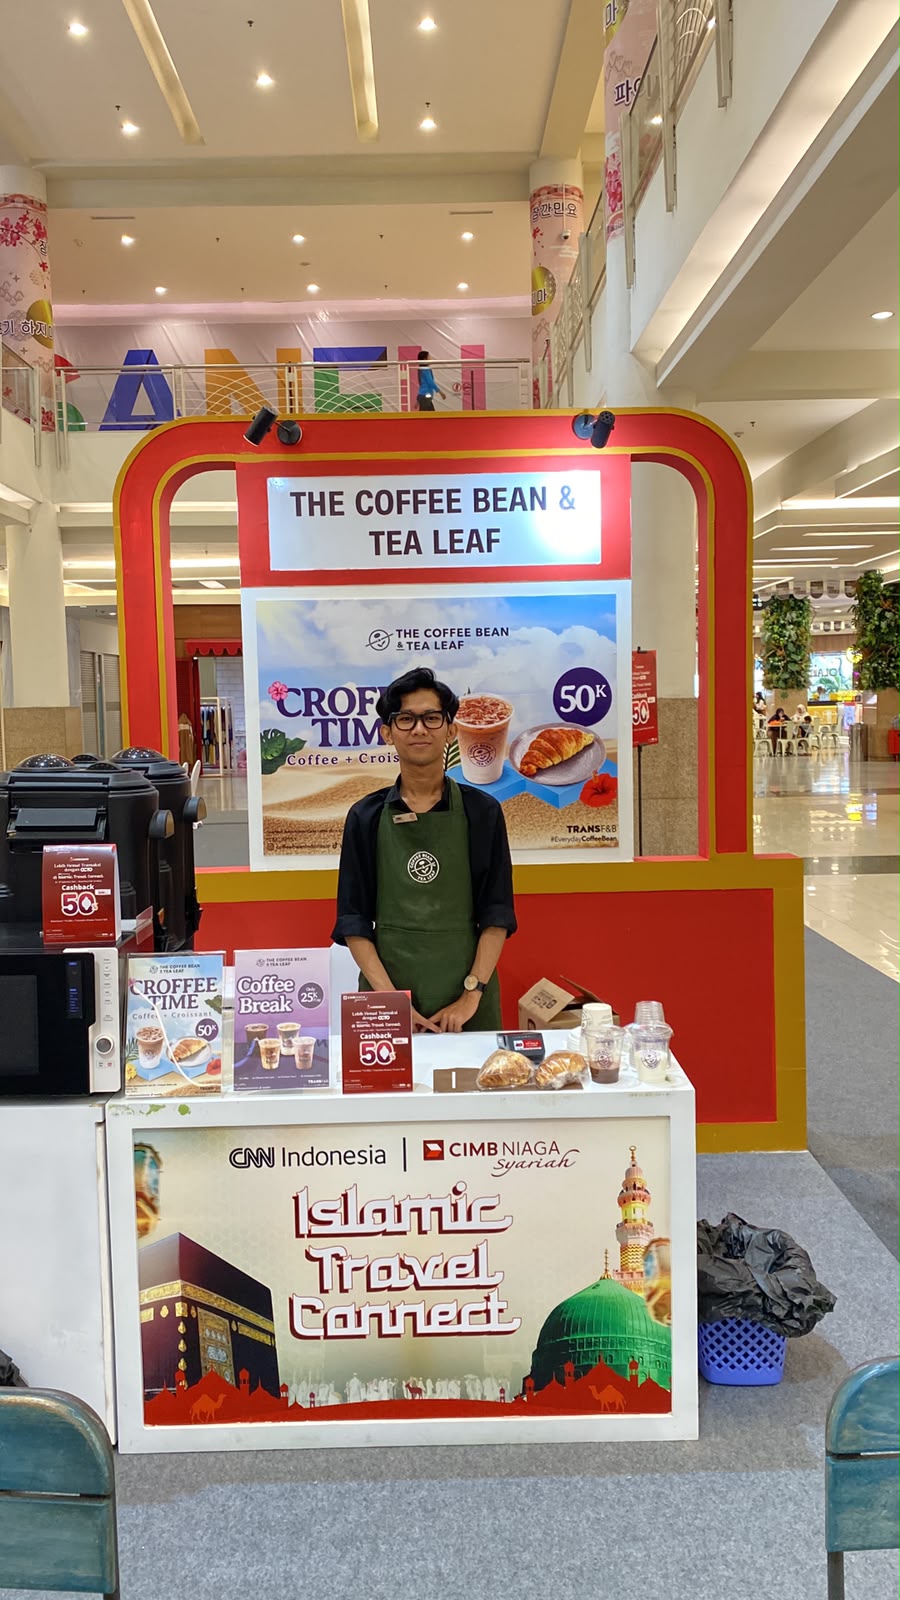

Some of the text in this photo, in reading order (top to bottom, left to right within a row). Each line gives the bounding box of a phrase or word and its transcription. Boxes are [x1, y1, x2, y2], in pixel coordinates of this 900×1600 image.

[290, 485, 576, 517] THE COFFEE BEAN &
[369, 528, 500, 556] TEA LEAF
[396, 627, 509, 638] THE COFFEE BEAN
[396, 640, 464, 651] & TEA LEAF
[560, 684, 607, 713] 50K
[286, 754, 338, 766] Coffee
[345, 756, 353, 764] +
[551, 835, 617, 843] #EverydayCoffeeBean
[130, 977, 218, 995] CROFFEE
[237, 975, 295, 993] Coffee
[148, 994, 199, 1010] TIME
[239, 997, 293, 1014] Break
[171, 1011, 212, 1019] Croissant
[360, 1032, 392, 1040] Cashback
[229, 1140, 560, 1169] CNN Indonesia CIMB NIAGA
[491, 1149, 580, 1177] syariah
[292, 1181, 513, 1238] Islamic
[305, 1239, 504, 1294] Travel
[288, 1287, 522, 1340] Connect
